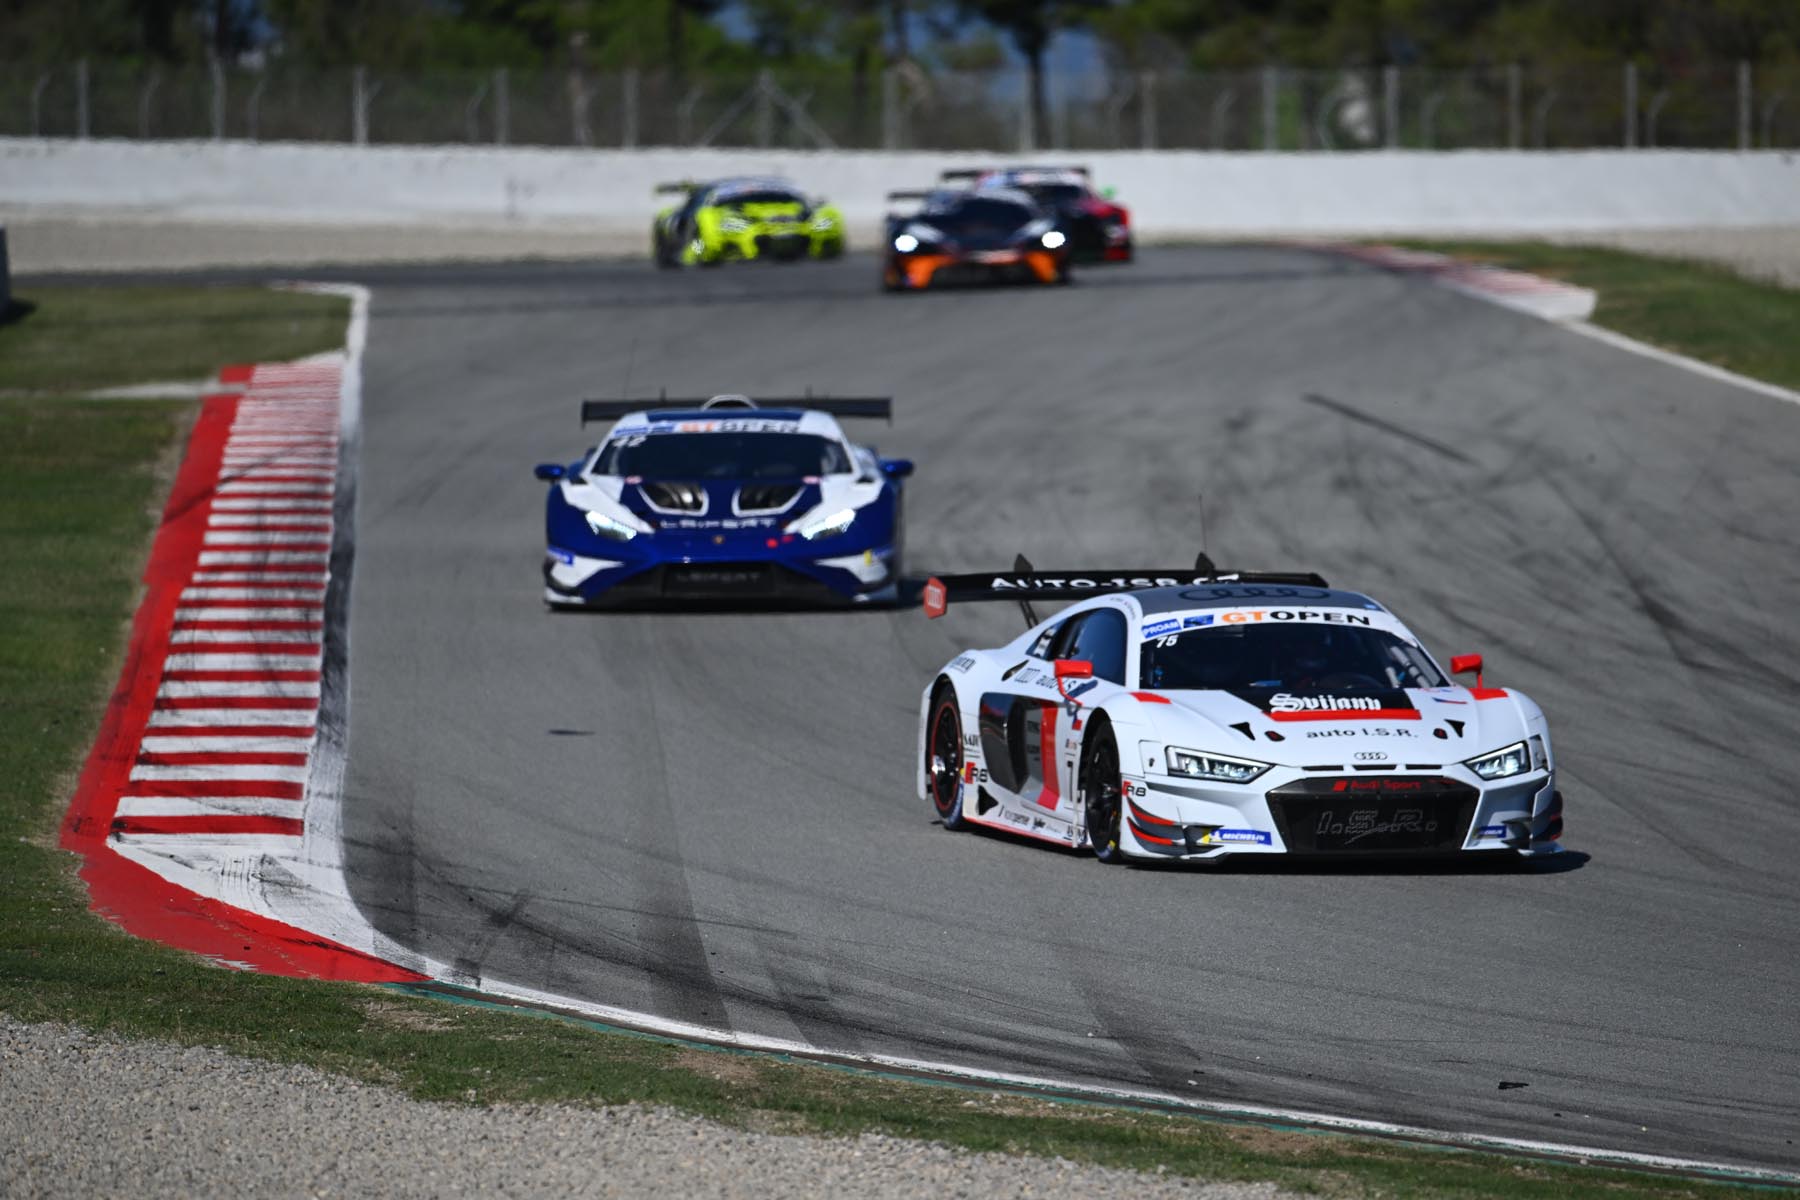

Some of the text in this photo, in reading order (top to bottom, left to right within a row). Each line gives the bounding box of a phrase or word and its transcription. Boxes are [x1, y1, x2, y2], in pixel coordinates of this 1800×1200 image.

[1156, 634, 1178, 648] 75
[1306, 726, 1419, 739] auto I.S.R.
[1350, 780, 1380, 790] Audi
[1383, 780, 1421, 792] Sport
[1221, 832, 1266, 842] MICHELIN
